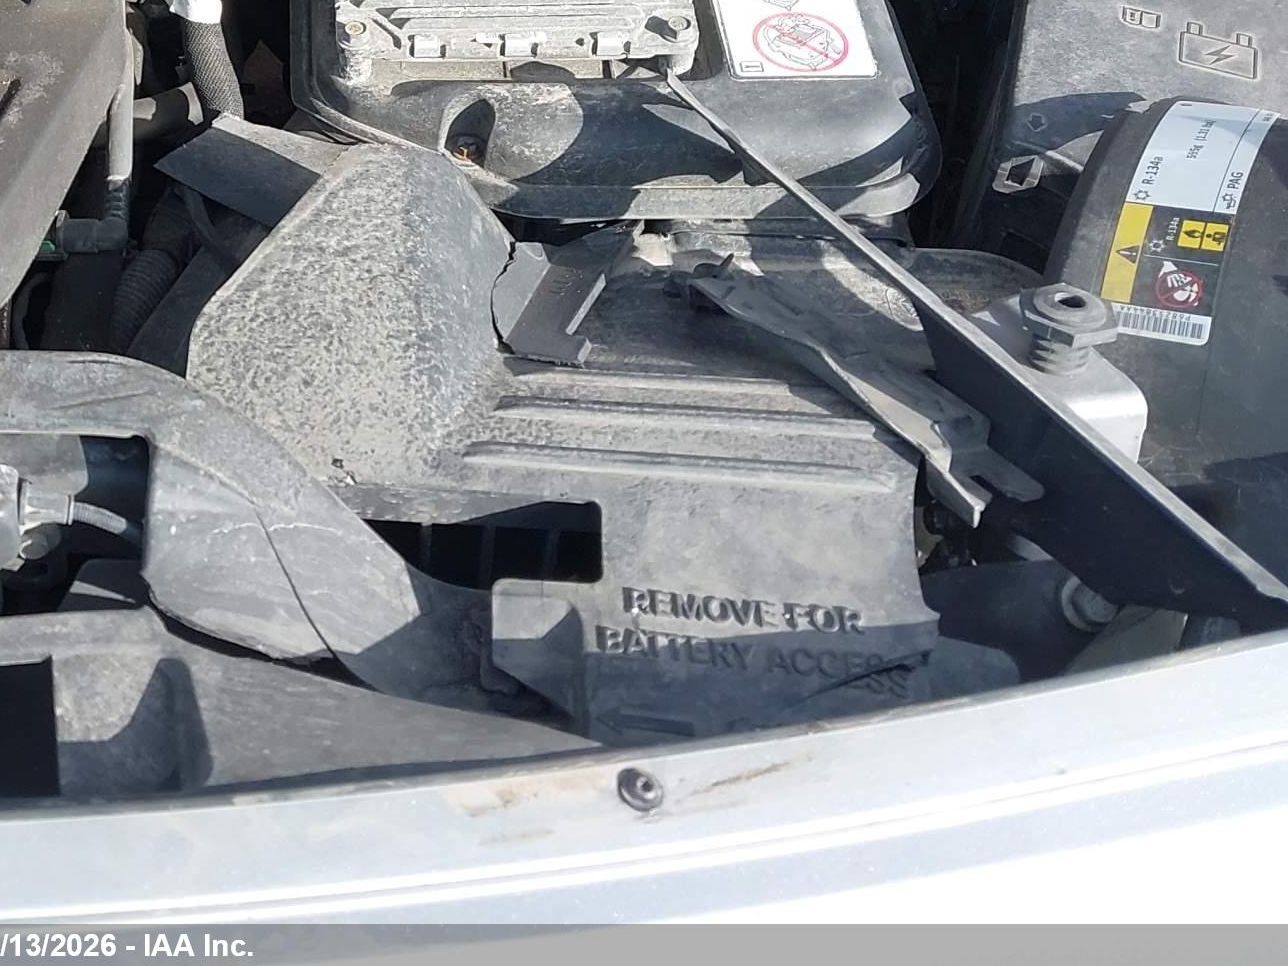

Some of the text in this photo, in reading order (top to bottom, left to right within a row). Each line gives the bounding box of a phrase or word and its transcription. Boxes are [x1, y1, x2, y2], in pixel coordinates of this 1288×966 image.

[1142, 156, 1164, 185] R-134a
[1227, 171, 1244, 190] PAG
[1165, 217, 1180, 241] R-134a
[621, 586, 866, 636] REMOVE FOR
[595, 624, 758, 669] BATTERY
